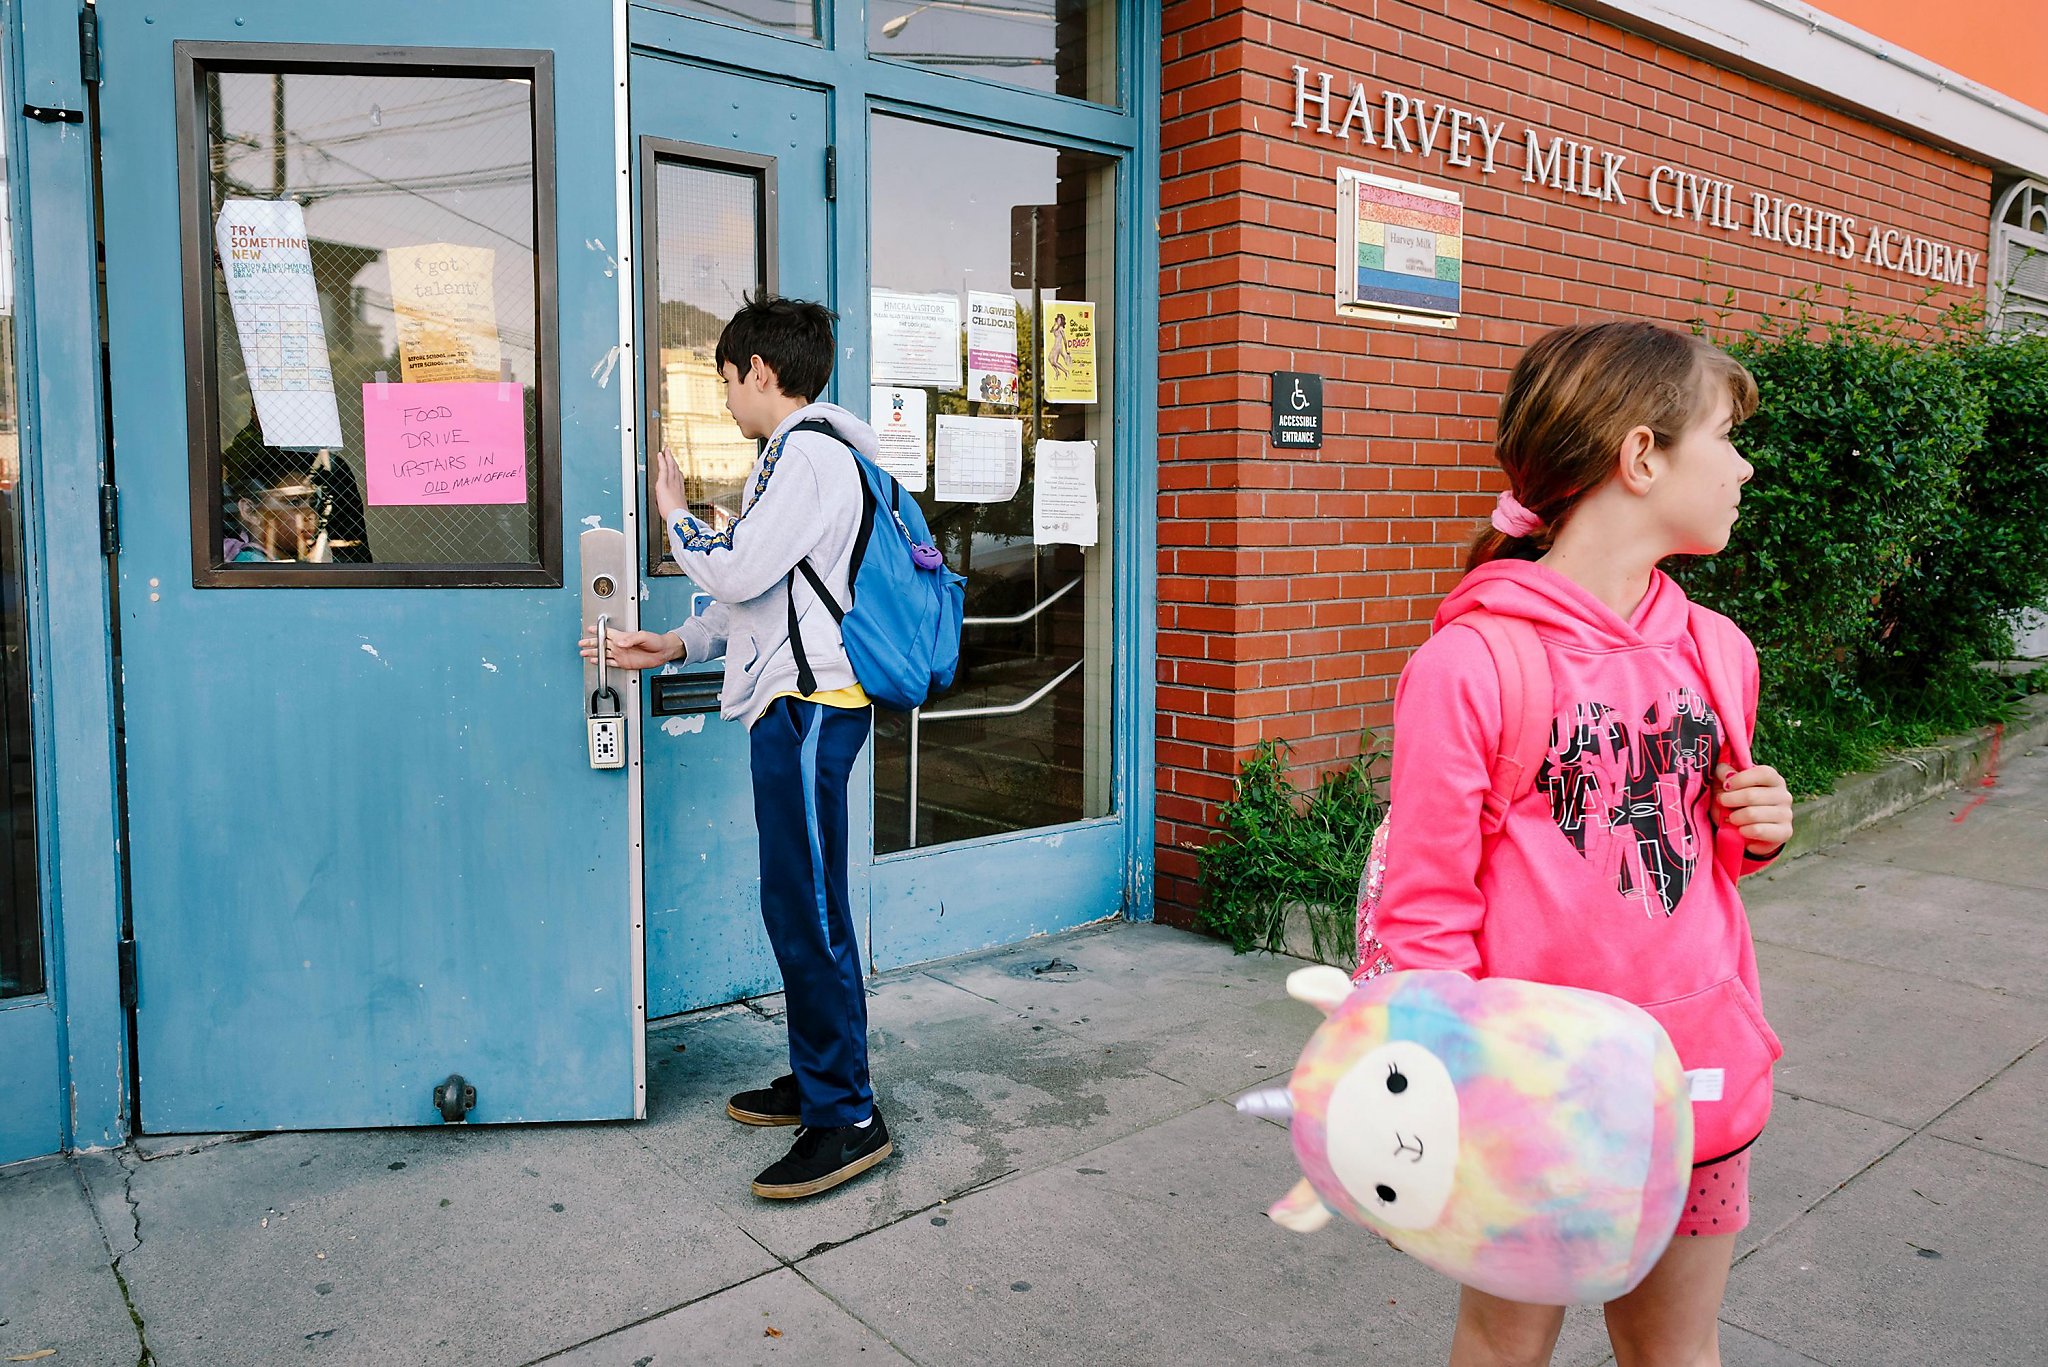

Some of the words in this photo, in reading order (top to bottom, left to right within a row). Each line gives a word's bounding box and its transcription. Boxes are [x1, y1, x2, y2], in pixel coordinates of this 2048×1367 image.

[1291, 64, 1505, 174] HARVEY
[1521, 129, 1627, 205] MILK
[1650, 165, 1739, 231] CIVIL
[1750, 192, 1855, 260] RIGHTS
[1861, 225, 1979, 288] ACADEMY
[230, 225, 256, 236] TRY
[231, 237, 307, 250] SOMETHING
[1390, 232, 1415, 247] Harvey
[1416, 237, 1432, 250] Milk
[232, 249, 261, 260] NEW
[428, 258, 459, 277] got
[414, 281, 479, 298] talent?
[1067, 338, 1091, 349] DRAG?
[404, 406, 452, 426] FOOD
[1279, 414, 1317, 428] ACCESSIBLE
[401, 430, 469, 448] DRIVE
[1281, 431, 1315, 443] ENTRANCE
[393, 456, 466, 478] UPSTAIRS
[479, 452, 494, 467] IN
[424, 481, 449, 494] OLD
[452, 473, 482, 490] MAIN
[484, 465, 523, 483] OFFICE!
